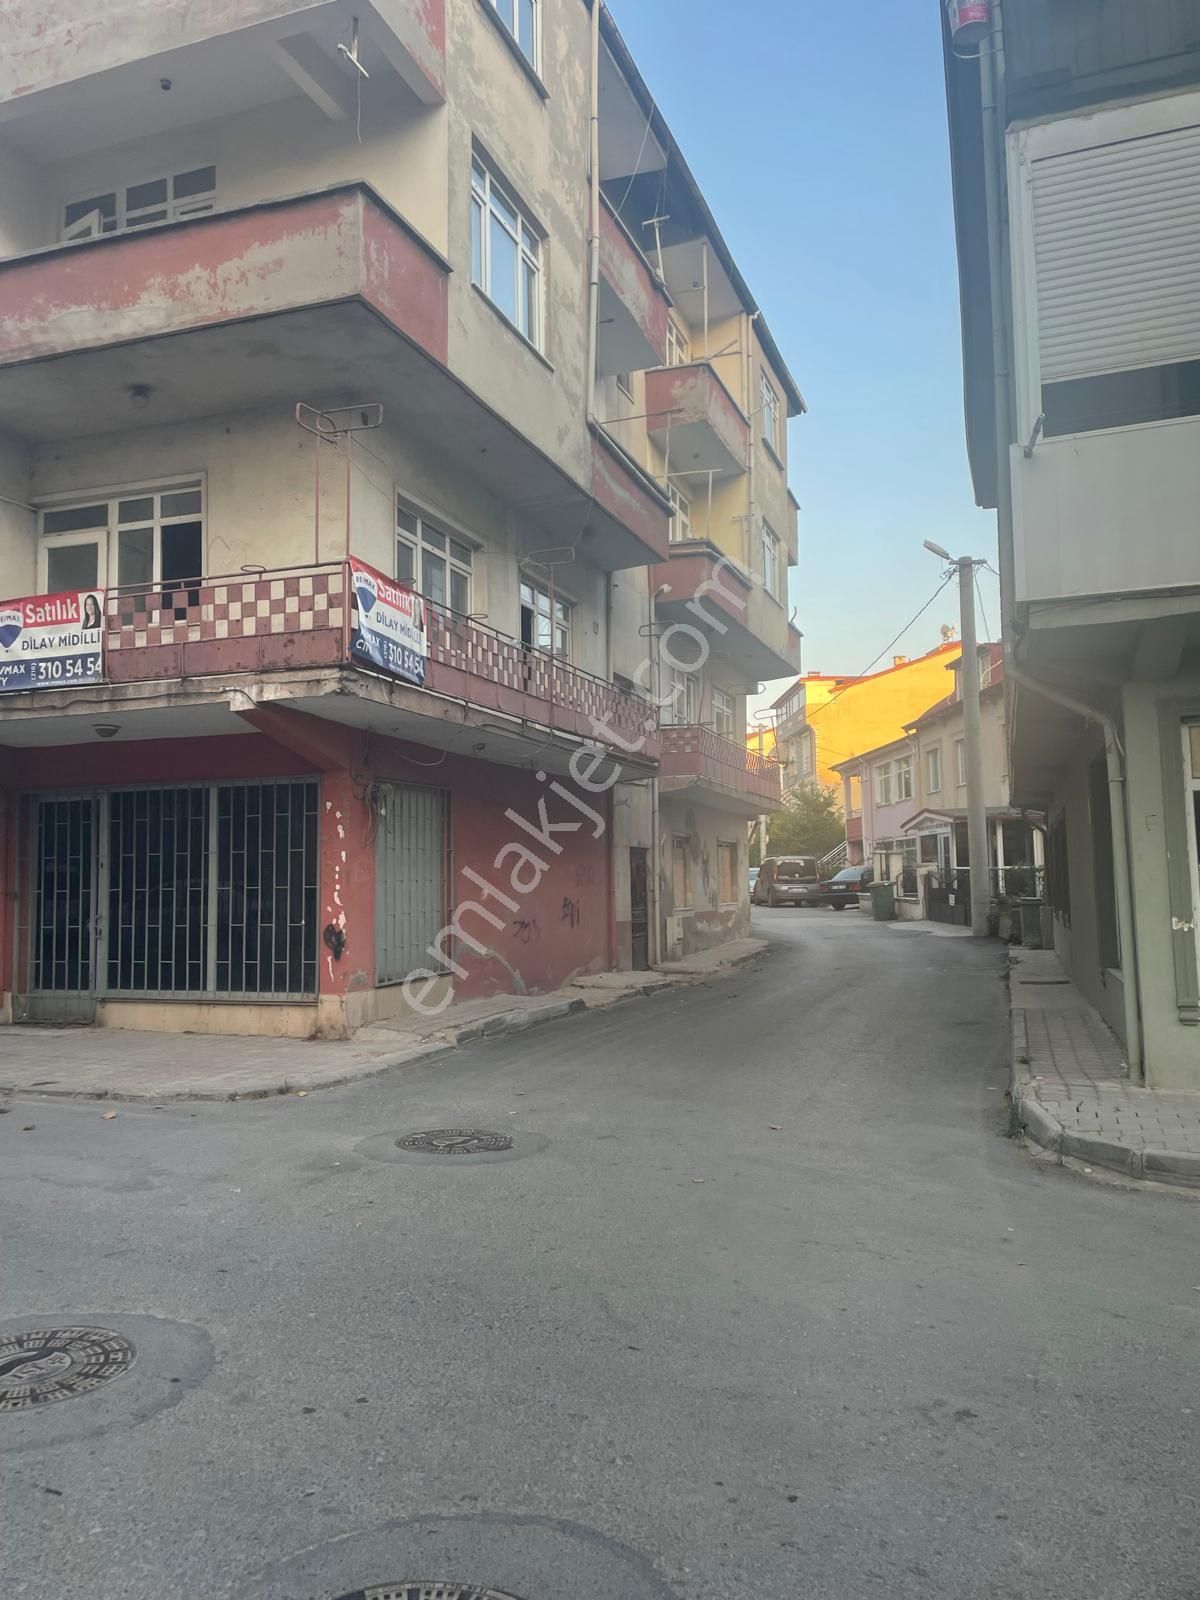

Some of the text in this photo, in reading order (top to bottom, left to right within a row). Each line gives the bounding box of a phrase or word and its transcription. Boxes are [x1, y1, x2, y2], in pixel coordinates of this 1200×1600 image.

[26, 599, 78, 624] Satılık
[376, 610, 399, 632] DİLAY
[22, 630, 100, 650] DİLAY MİDİLLİ
[388, 641, 404, 666] 310
[39, 656, 102, 679] 310 54 54
